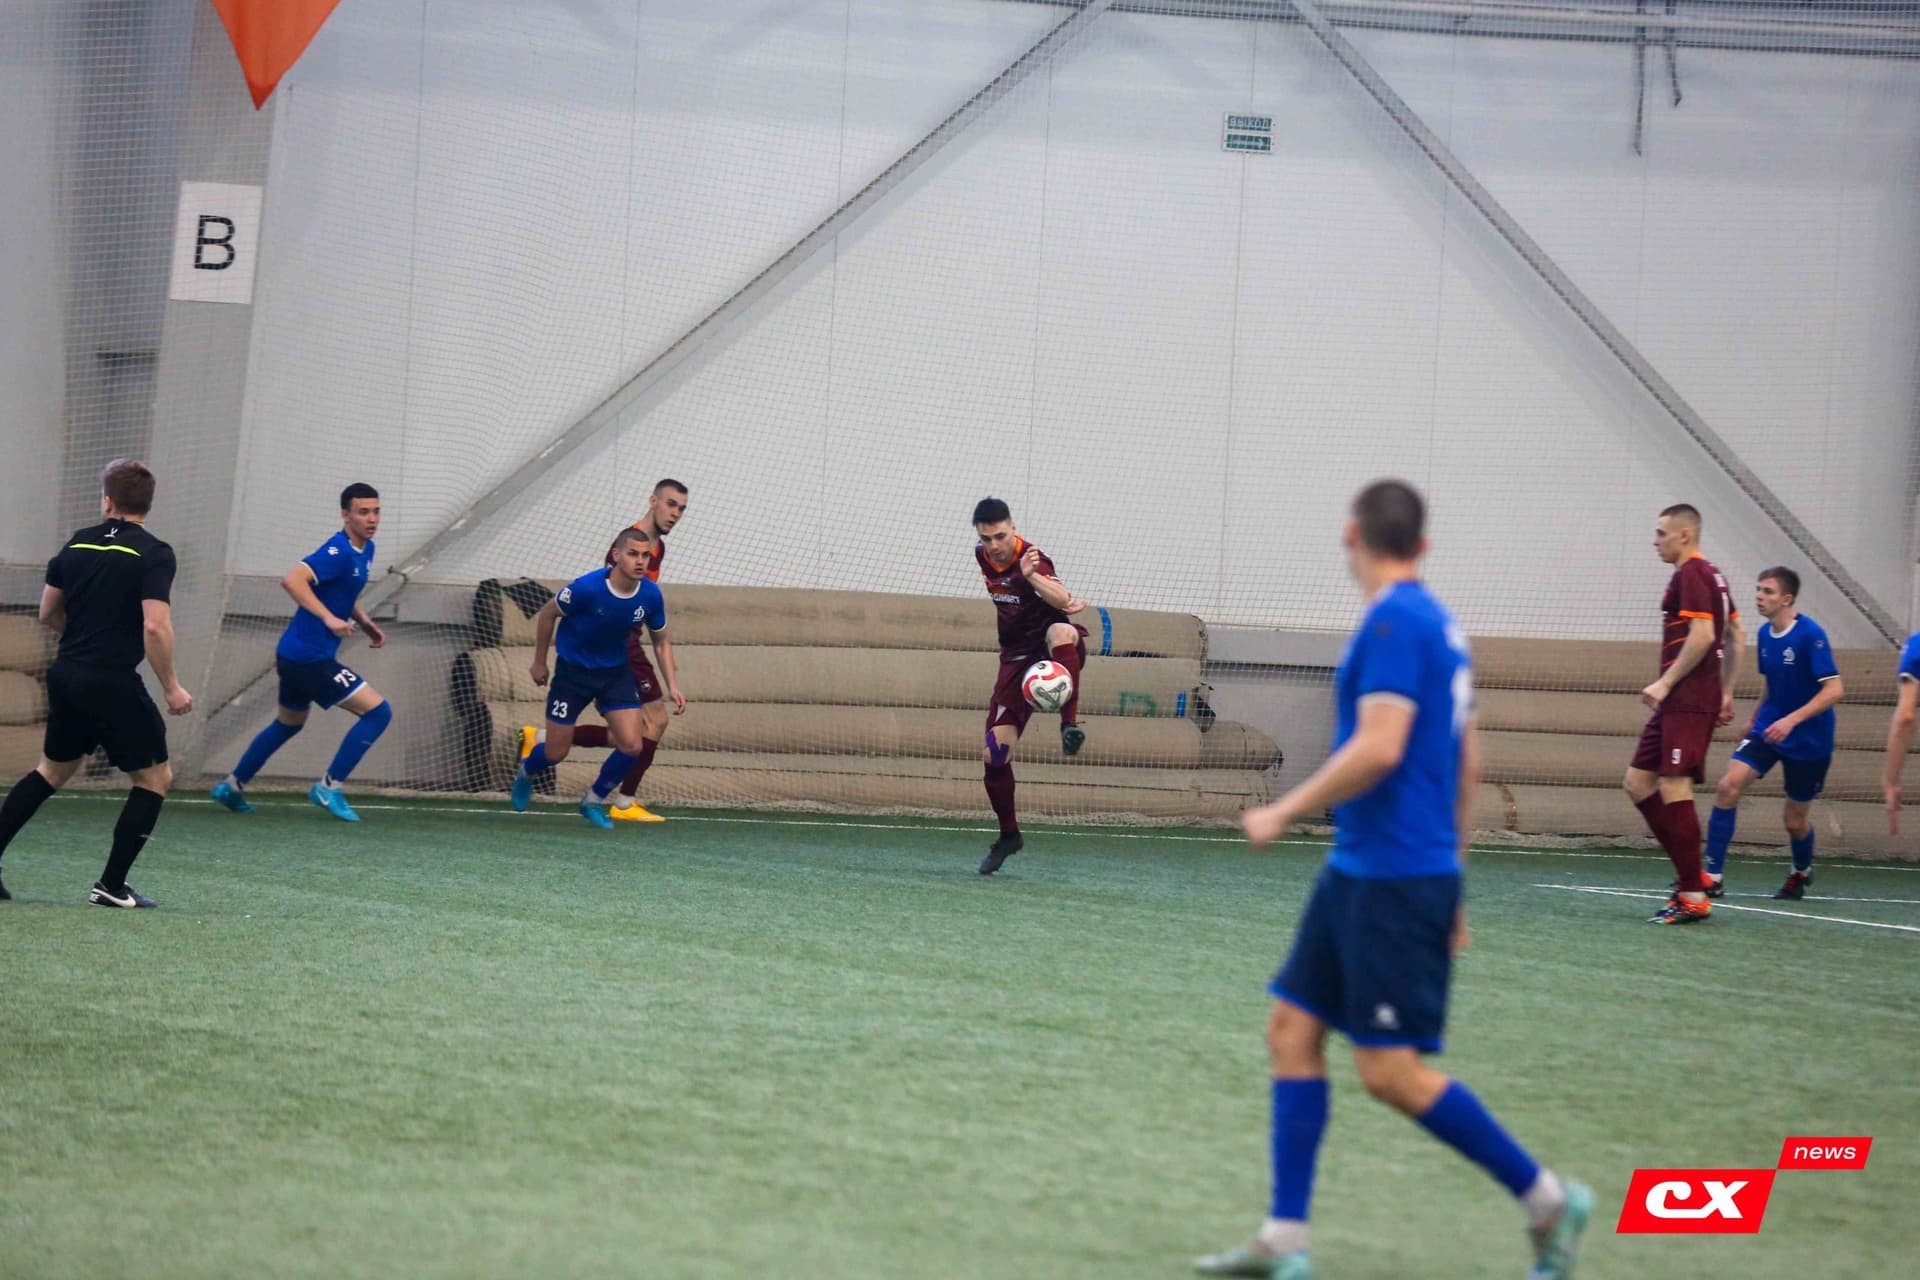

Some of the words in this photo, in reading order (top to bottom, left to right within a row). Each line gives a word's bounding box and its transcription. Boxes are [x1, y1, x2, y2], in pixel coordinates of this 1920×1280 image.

[193, 214, 236, 270] B
[333, 668, 357, 689] 73
[551, 699, 569, 719] 23
[1671, 748, 1682, 764] 9
